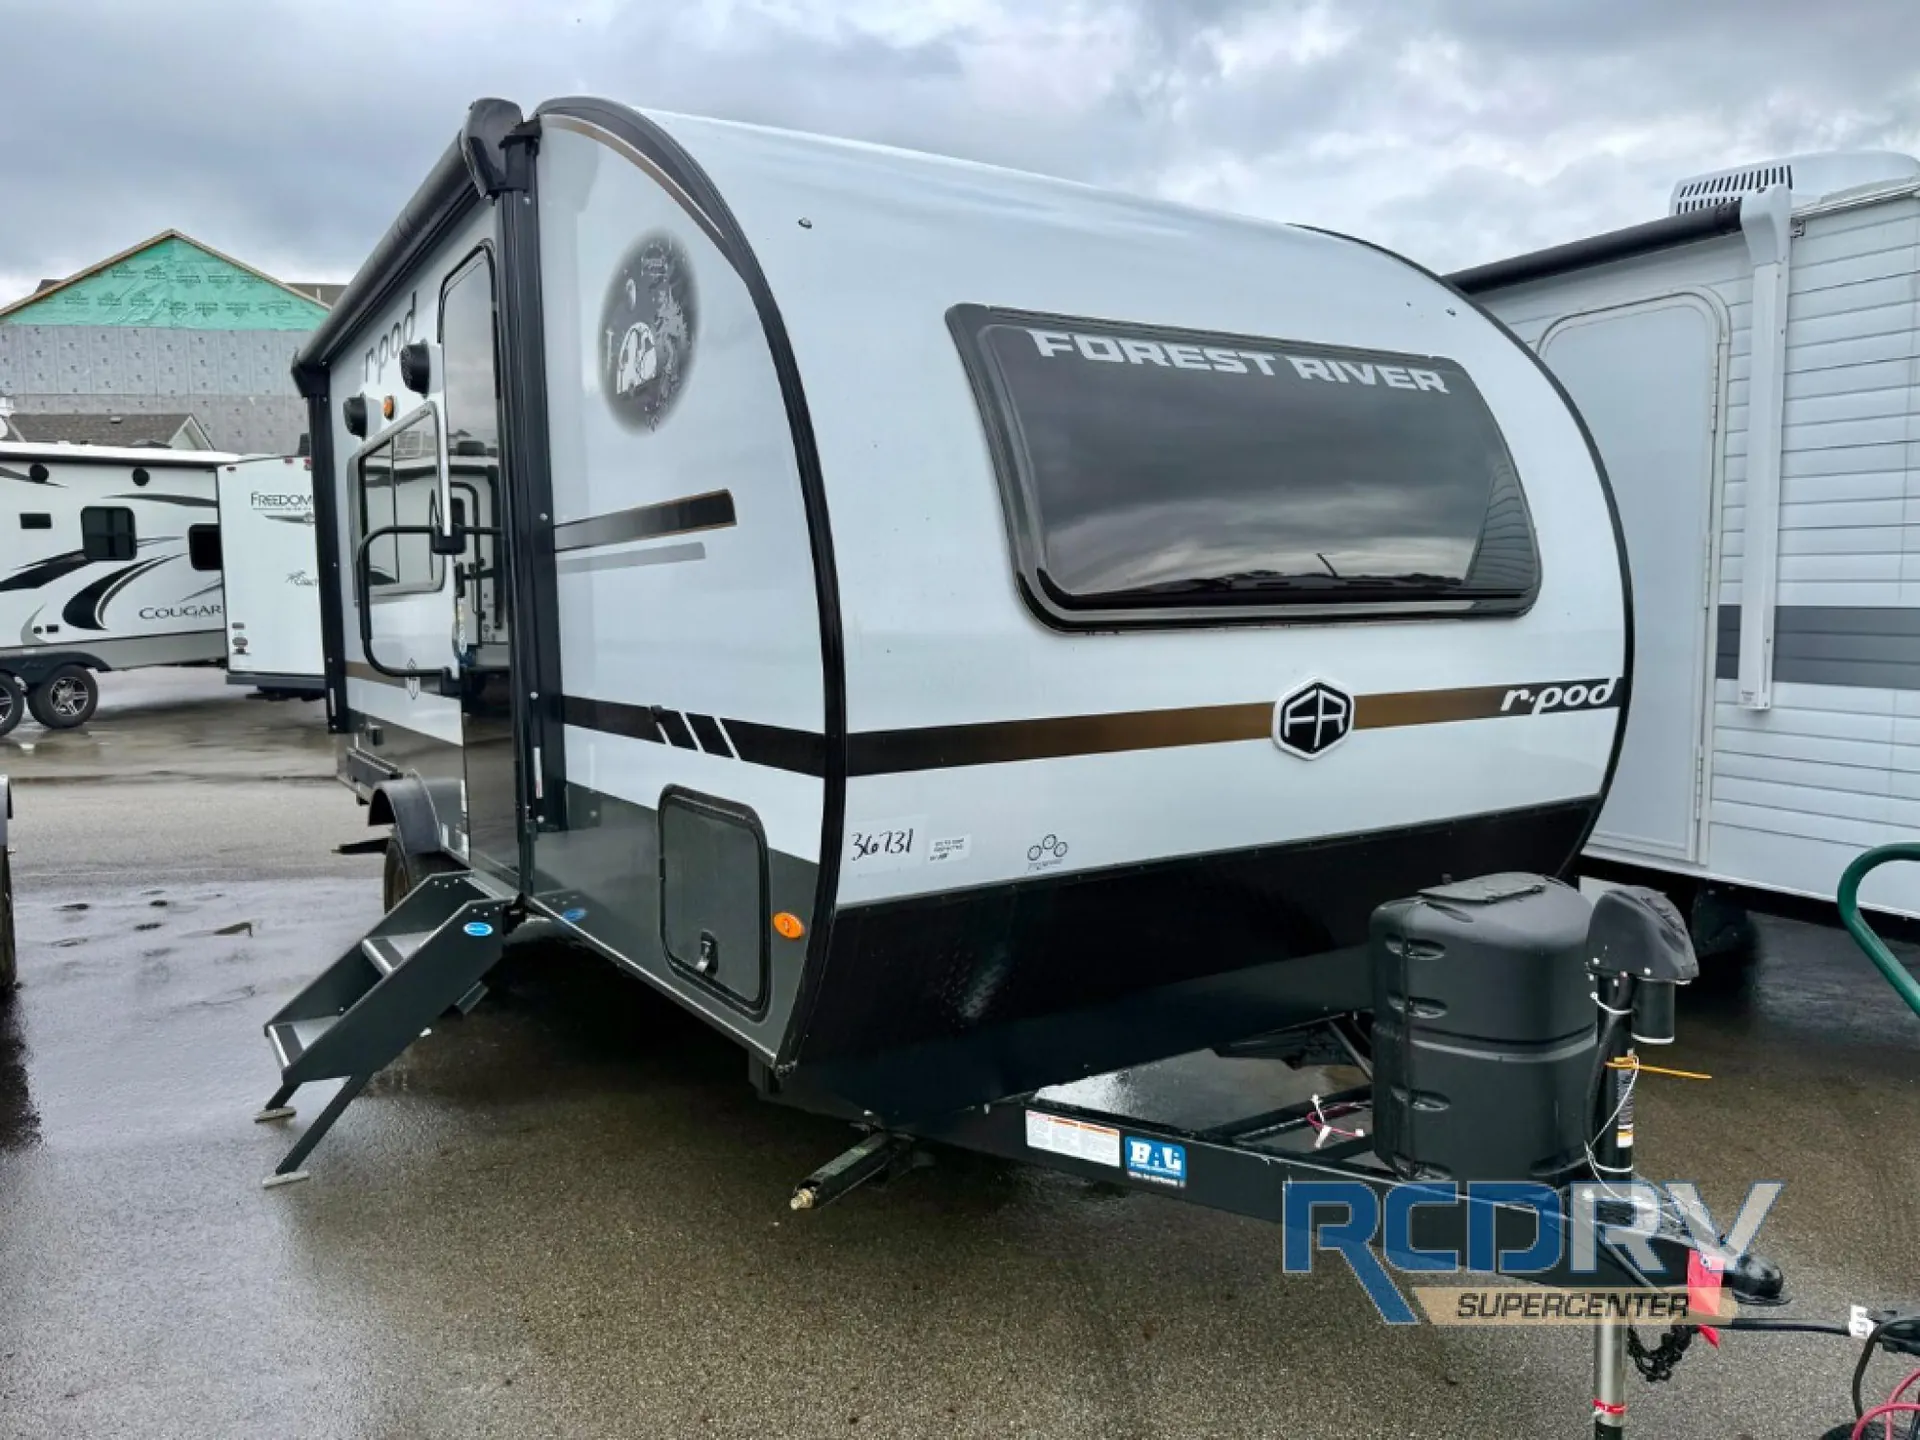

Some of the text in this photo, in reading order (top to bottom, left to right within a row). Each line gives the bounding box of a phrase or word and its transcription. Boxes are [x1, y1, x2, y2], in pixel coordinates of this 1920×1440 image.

[1025, 329, 1450, 394] FOREST RIVER
[250, 491, 313, 507] FREEDOM
[138, 604, 222, 620] COUGAR
[851, 827, 914, 861] 36731
